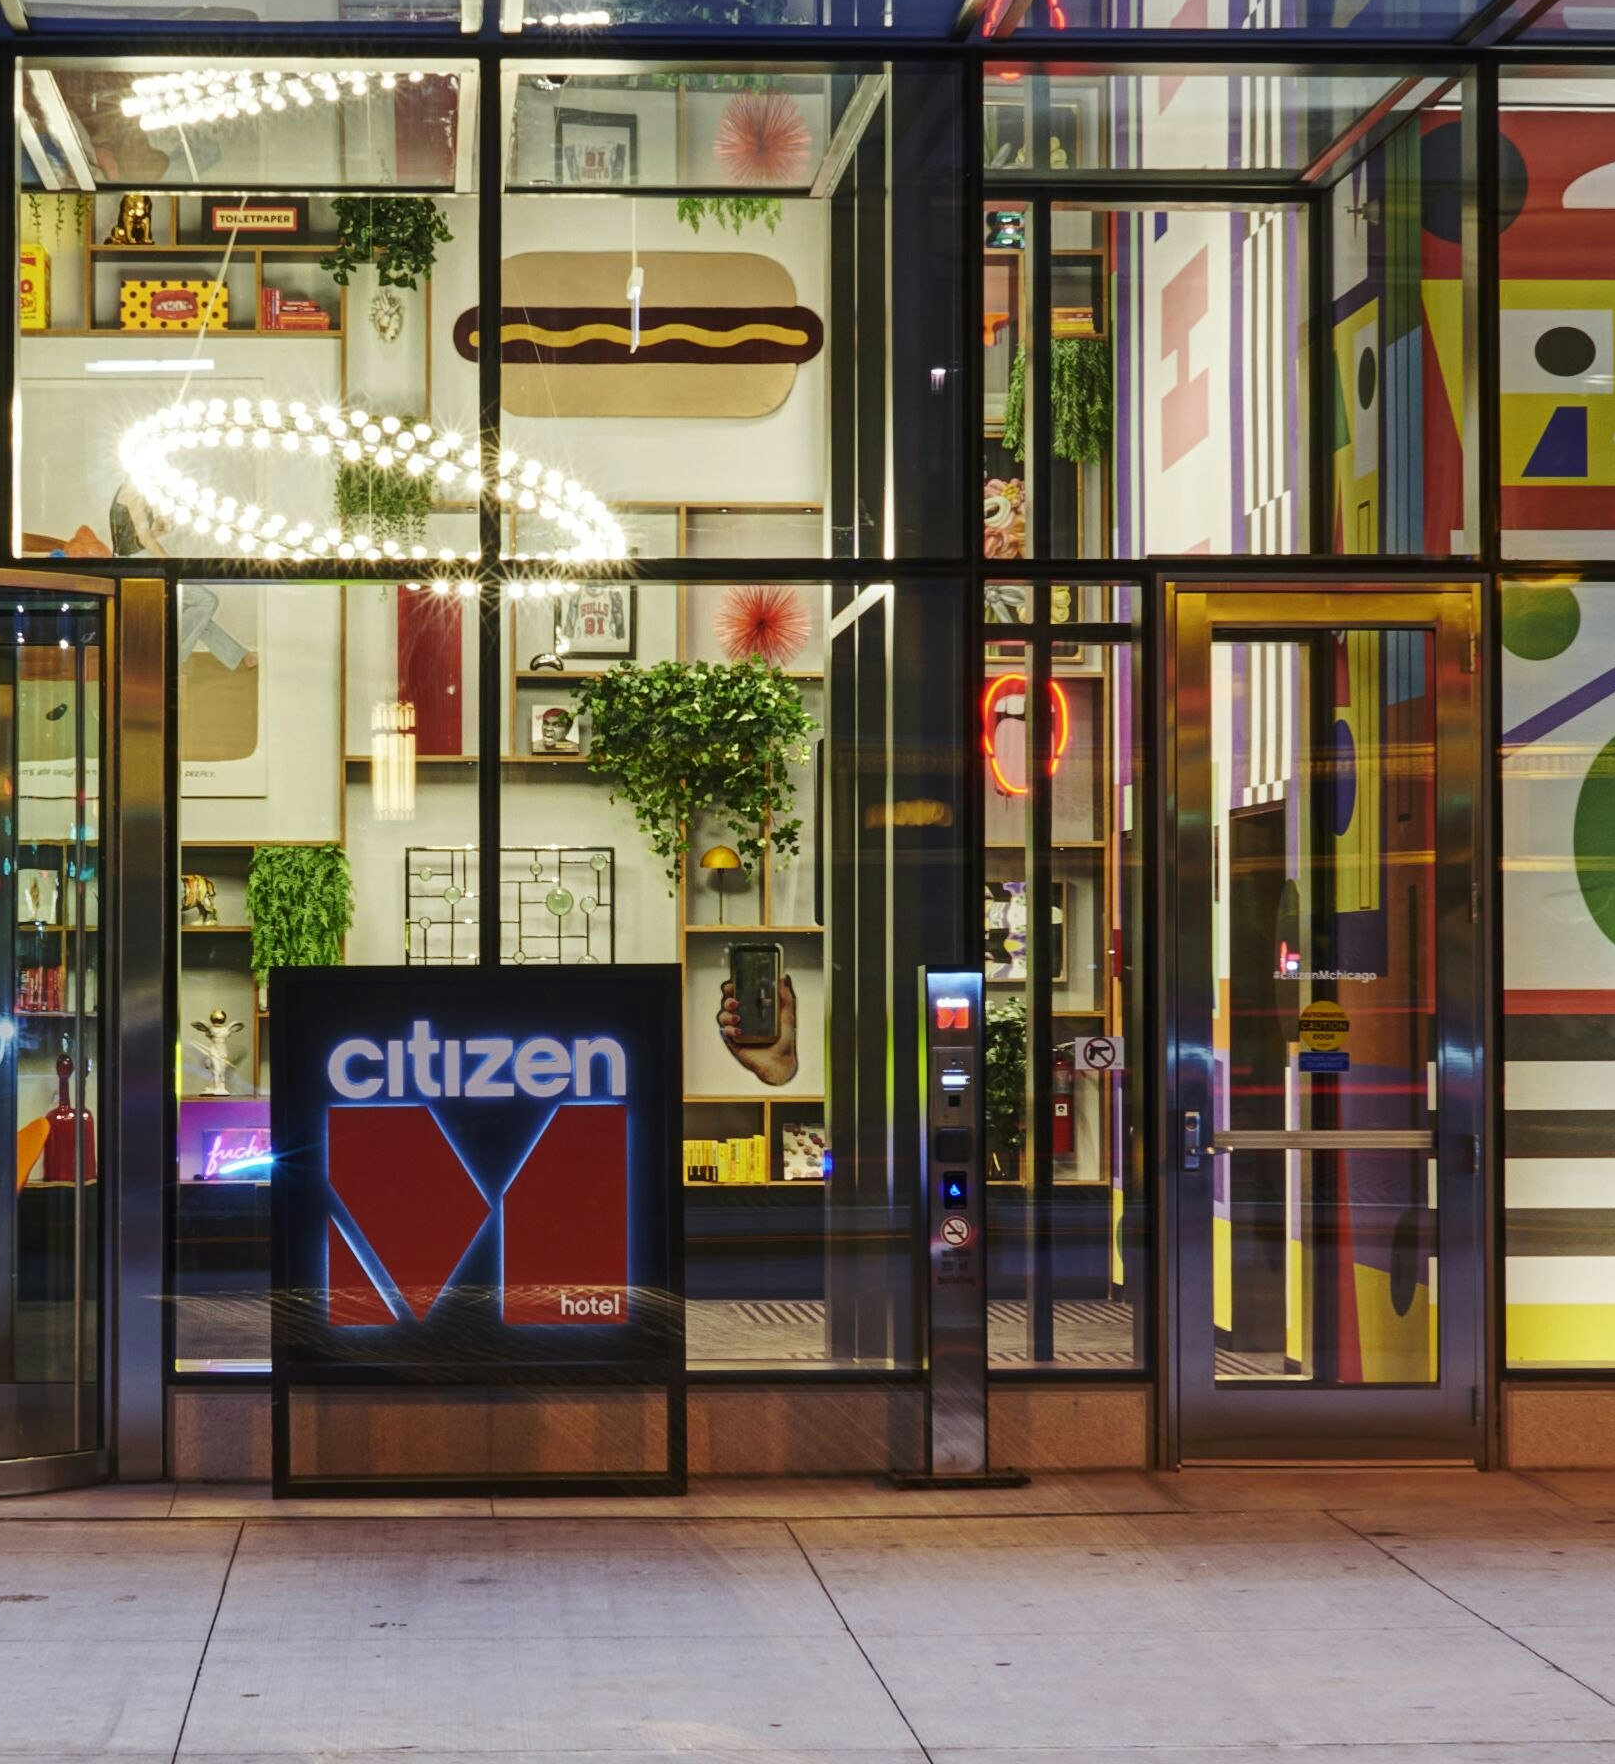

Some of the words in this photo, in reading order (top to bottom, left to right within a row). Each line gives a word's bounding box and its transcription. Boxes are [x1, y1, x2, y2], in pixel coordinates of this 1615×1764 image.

[584, 617, 605, 636] 91
[1300, 1021, 1347, 1030] CAUTION
[328, 1020, 627, 1099] citizen
[560, 1294, 621, 1316] hotel
